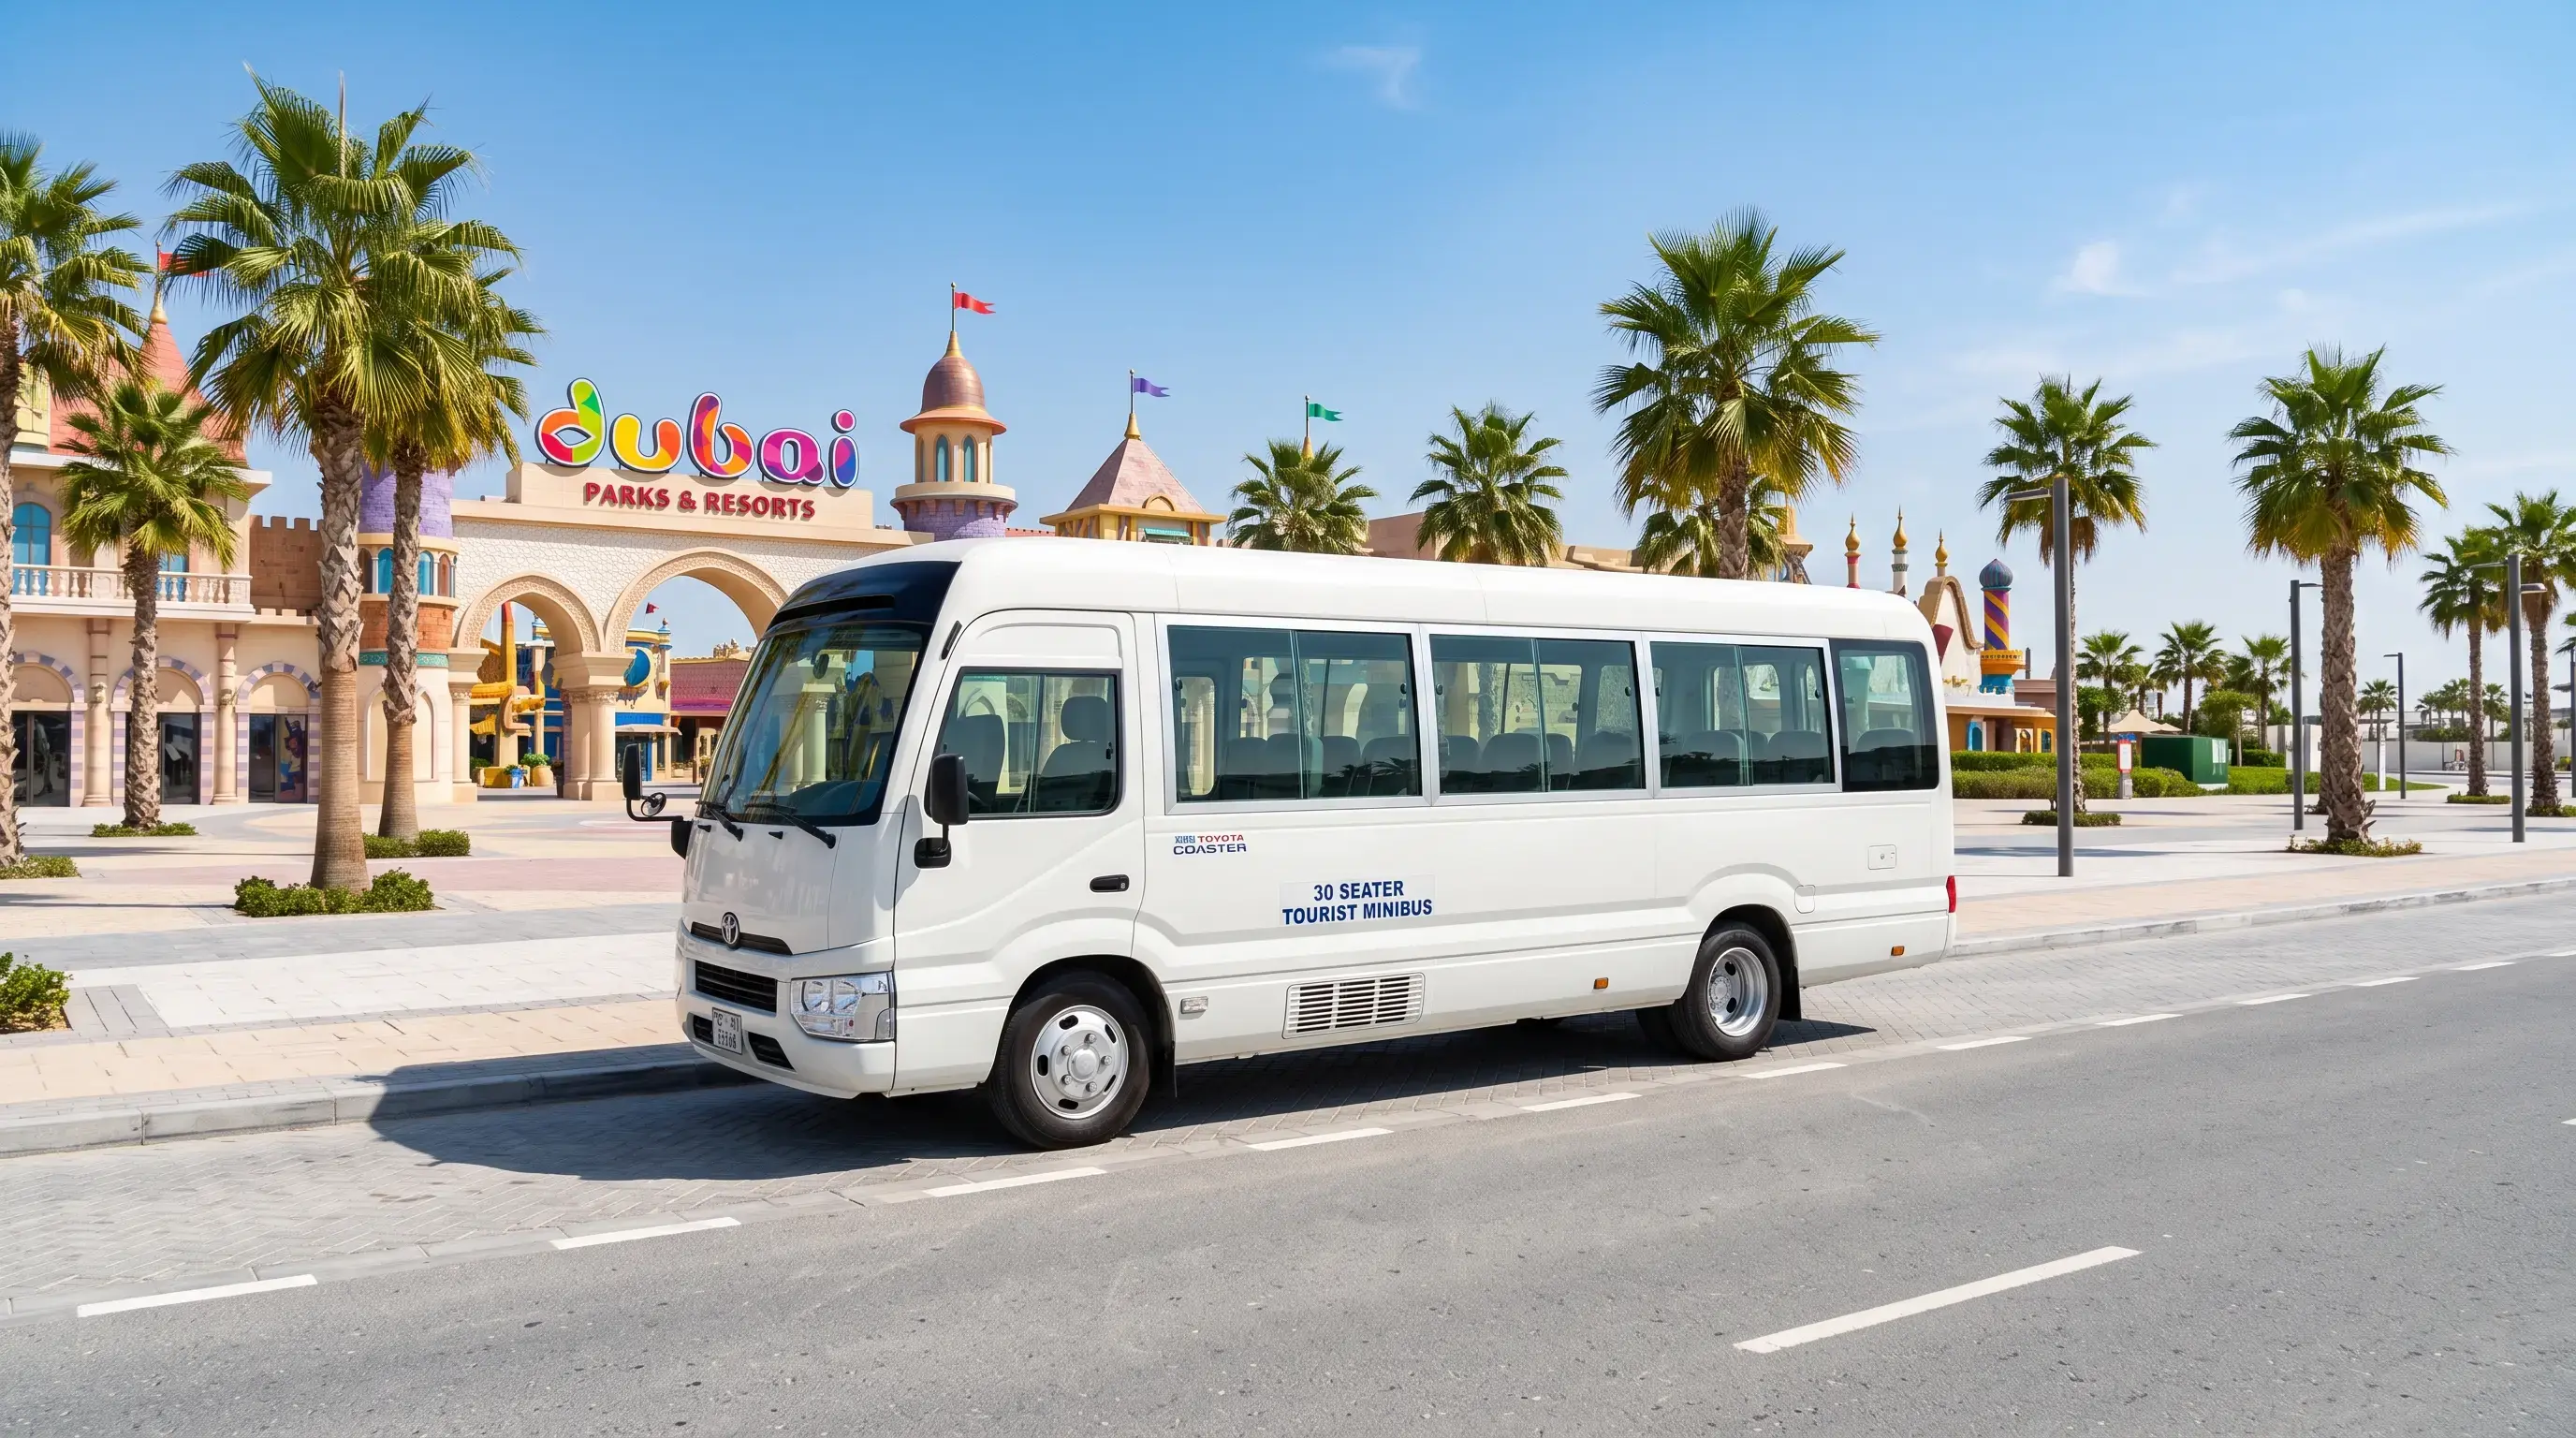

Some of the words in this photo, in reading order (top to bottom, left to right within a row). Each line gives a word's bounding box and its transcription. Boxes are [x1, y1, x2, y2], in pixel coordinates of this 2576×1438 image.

[534, 377, 859, 490] dubai
[583, 482, 670, 508] PARKS
[679, 490, 697, 510] &
[704, 492, 816, 519] RESORTS
[1173, 843, 1247, 855] COASTER
[1198, 834, 1244, 843] TOYOTA
[1313, 884, 1334, 902] 30
[1339, 880, 1404, 900] SEATER
[1281, 903, 1357, 925] TOURIST
[1363, 899, 1433, 919] MINIBUS
